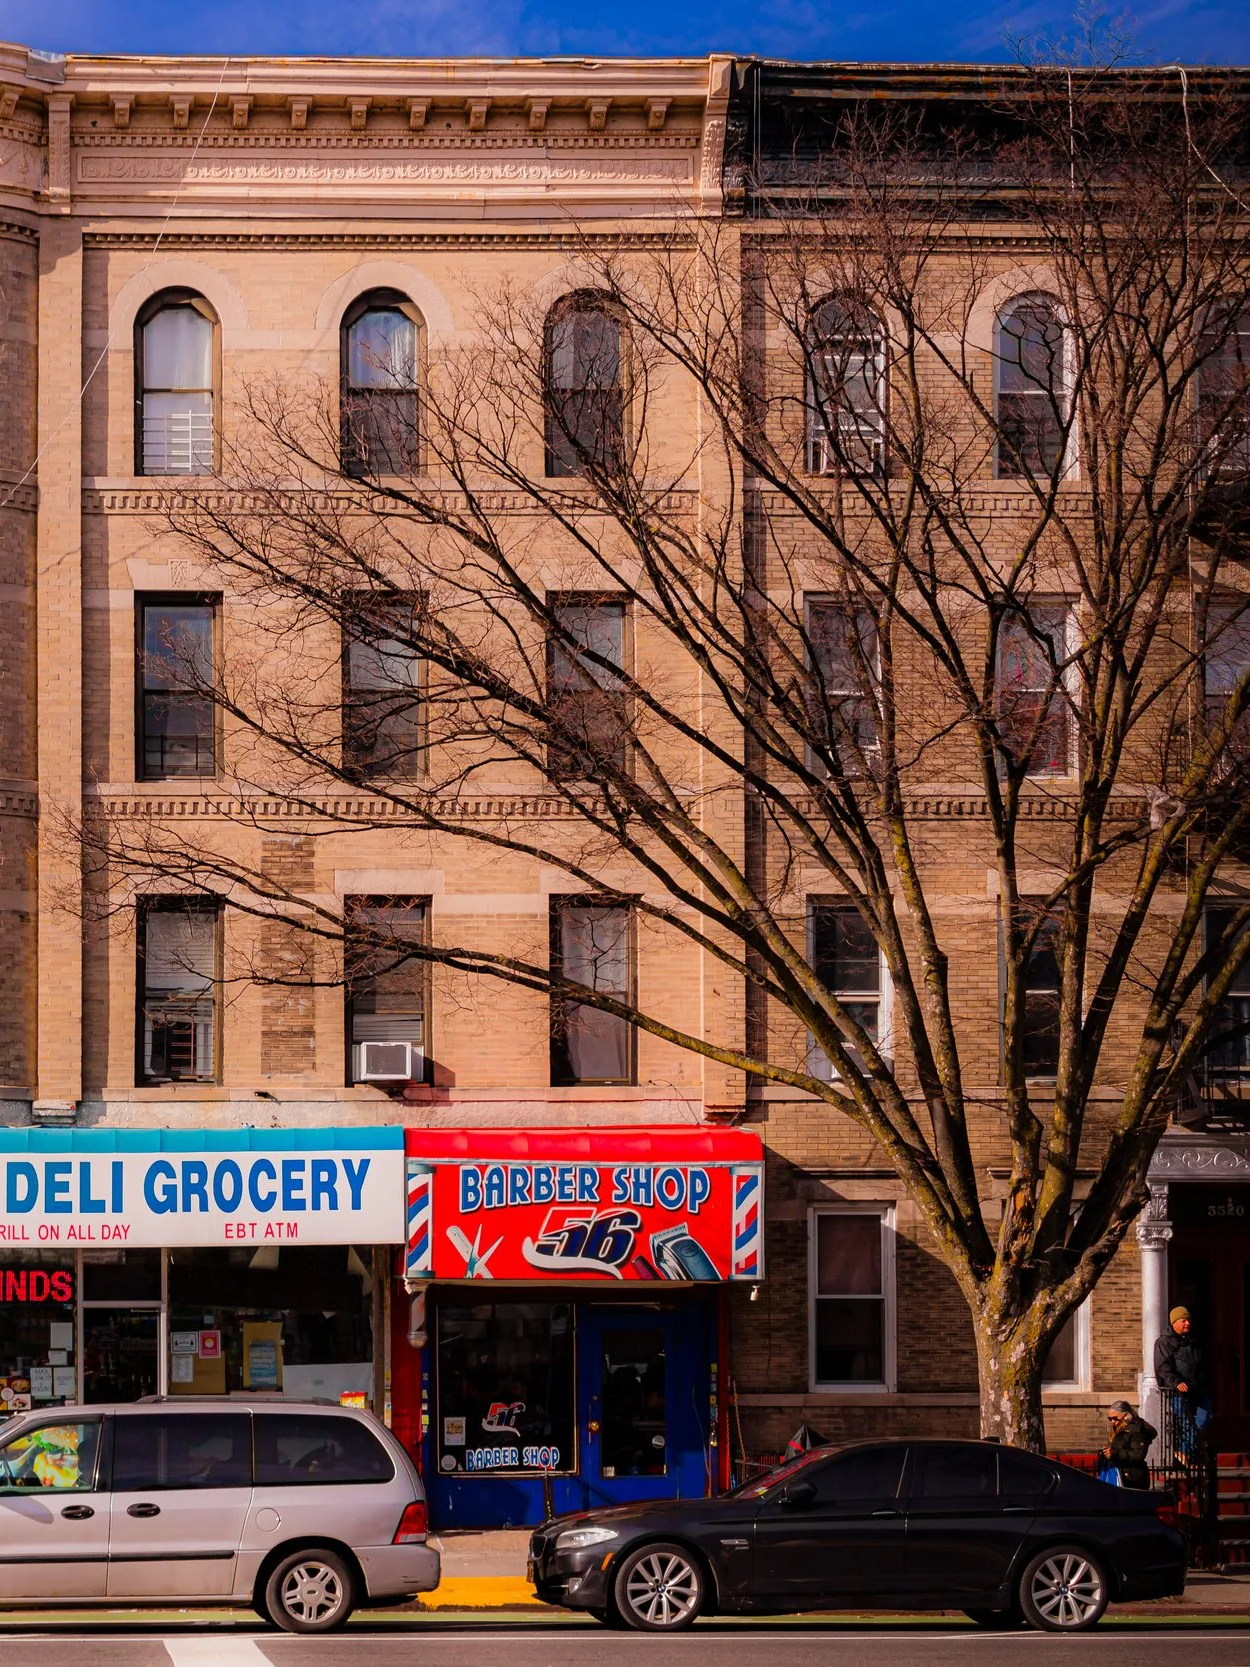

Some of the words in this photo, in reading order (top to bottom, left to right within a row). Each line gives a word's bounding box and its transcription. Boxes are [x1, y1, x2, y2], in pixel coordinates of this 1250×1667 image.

[6, 1160, 124, 1215] DELI
[143, 1158, 371, 1215] GROCERY
[459, 1165, 600, 1214] BARBER
[612, 1166, 710, 1214] SHOP
[37, 1224, 61, 1241] ON
[66, 1224, 96, 1241] ALL
[100, 1223, 131, 1241] DAY
[224, 1221, 258, 1240] EBT
[263, 1221, 299, 1239] ATM
[536, 1207, 642, 1266] 56
[465, 1447, 519, 1471] BARBER
[522, 1446, 560, 1469] SHOP
